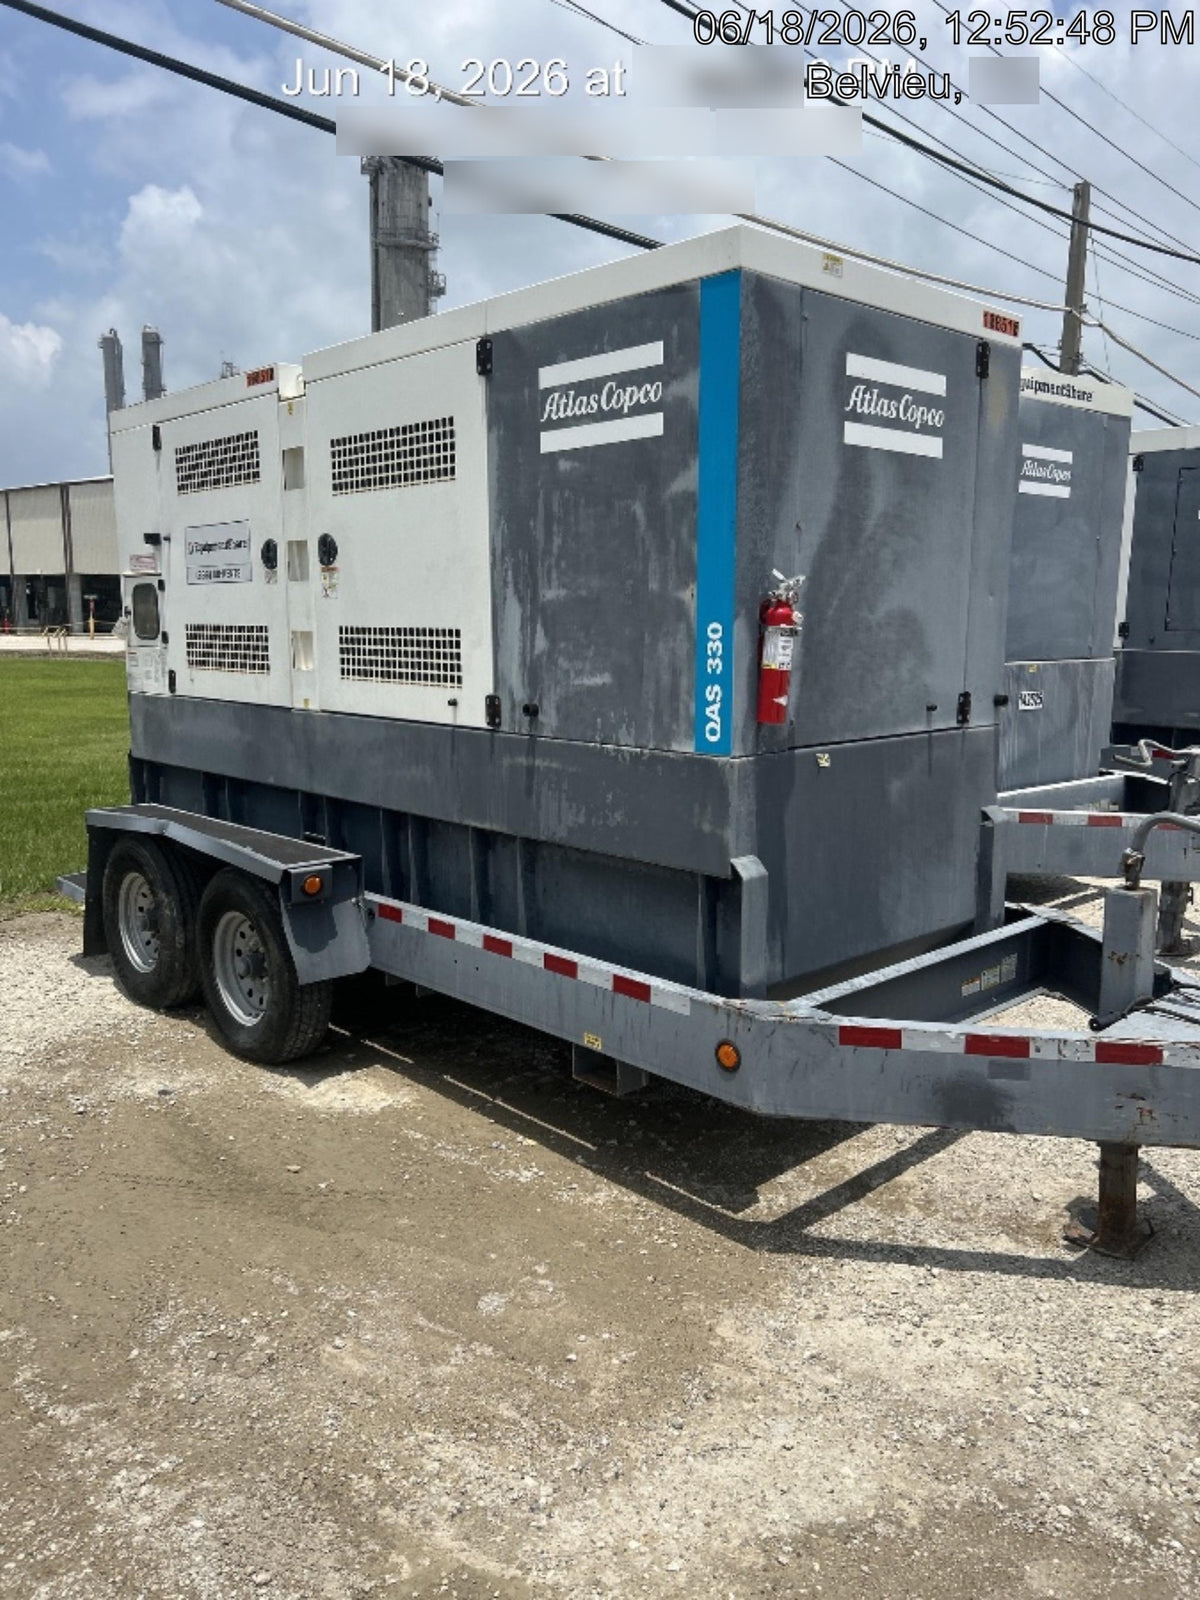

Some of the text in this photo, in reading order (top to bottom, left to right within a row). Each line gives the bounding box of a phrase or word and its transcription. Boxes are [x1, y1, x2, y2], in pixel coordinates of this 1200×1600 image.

[540, 381, 663, 422] Atlas Copco
[844, 384, 945, 430] Atlas Copco
[1020, 376, 1093, 402] quipmentShare
[705, 621, 723, 742] QAS 330
